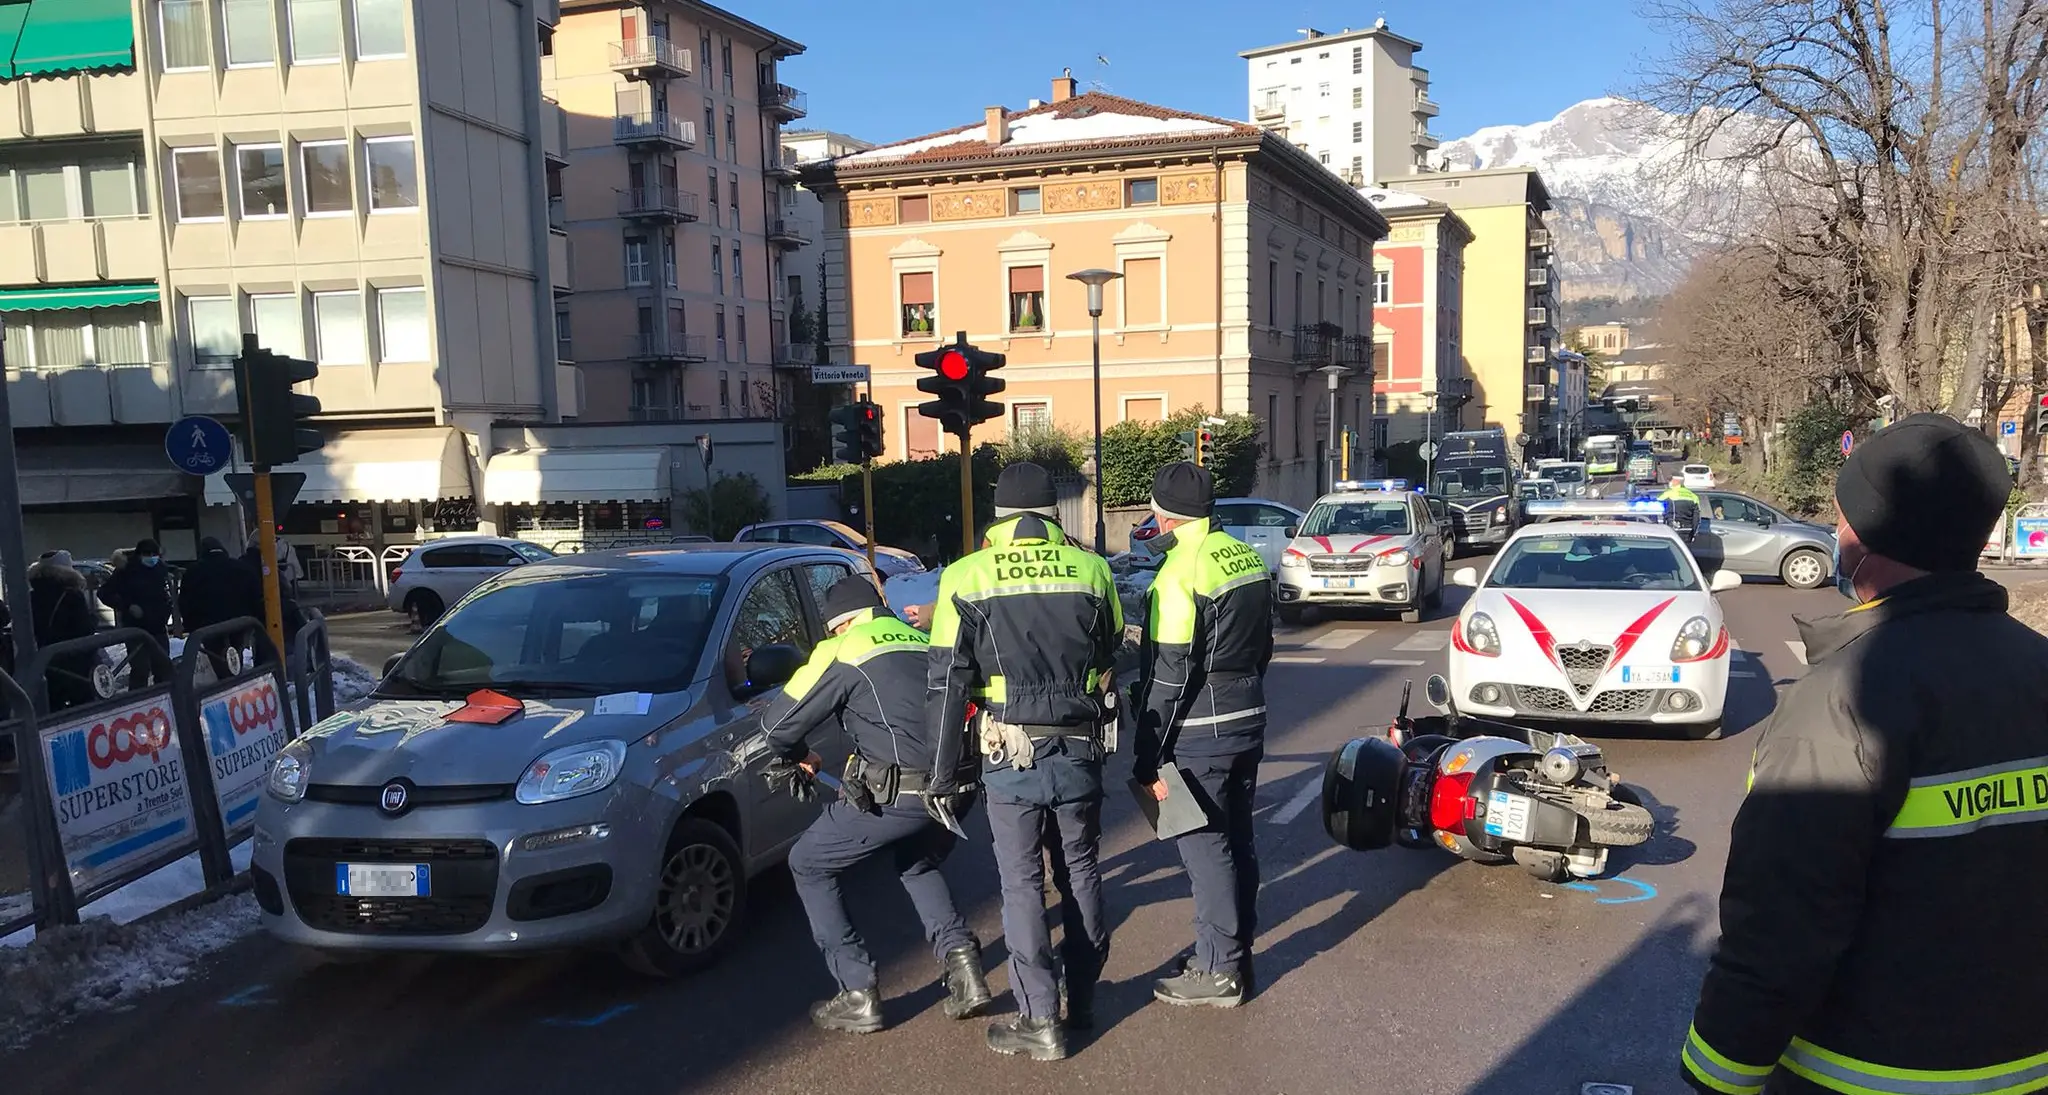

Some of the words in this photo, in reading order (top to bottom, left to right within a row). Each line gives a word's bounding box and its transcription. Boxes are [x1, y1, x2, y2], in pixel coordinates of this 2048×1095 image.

[814, 371, 840, 380] Vittorio
[841, 371, 864, 379] Veneto
[441, 518, 466, 526] BAR
[994, 549, 1061, 564] POLIZI
[1220, 555, 1263, 576] LOCALE
[997, 565, 1078, 581] LOCALE
[870, 633, 930, 645] LOCAL
[229, 684, 278, 736] coop
[88, 707, 171, 770] coop
[215, 729, 285, 780] SUPERSTORE
[60, 760, 180, 825] SUPERSTORE
[137, 803, 143, 812] a
[144, 793, 169, 809] Trento
[170, 784, 184, 800] Sud
[386, 791, 402, 804] FIAT
[1943, 777, 2025, 818] VIGILI
[2032, 774, 2048, 805] D
[1488, 808, 1505, 825] BX
[1507, 799, 1526, 834] 12011
